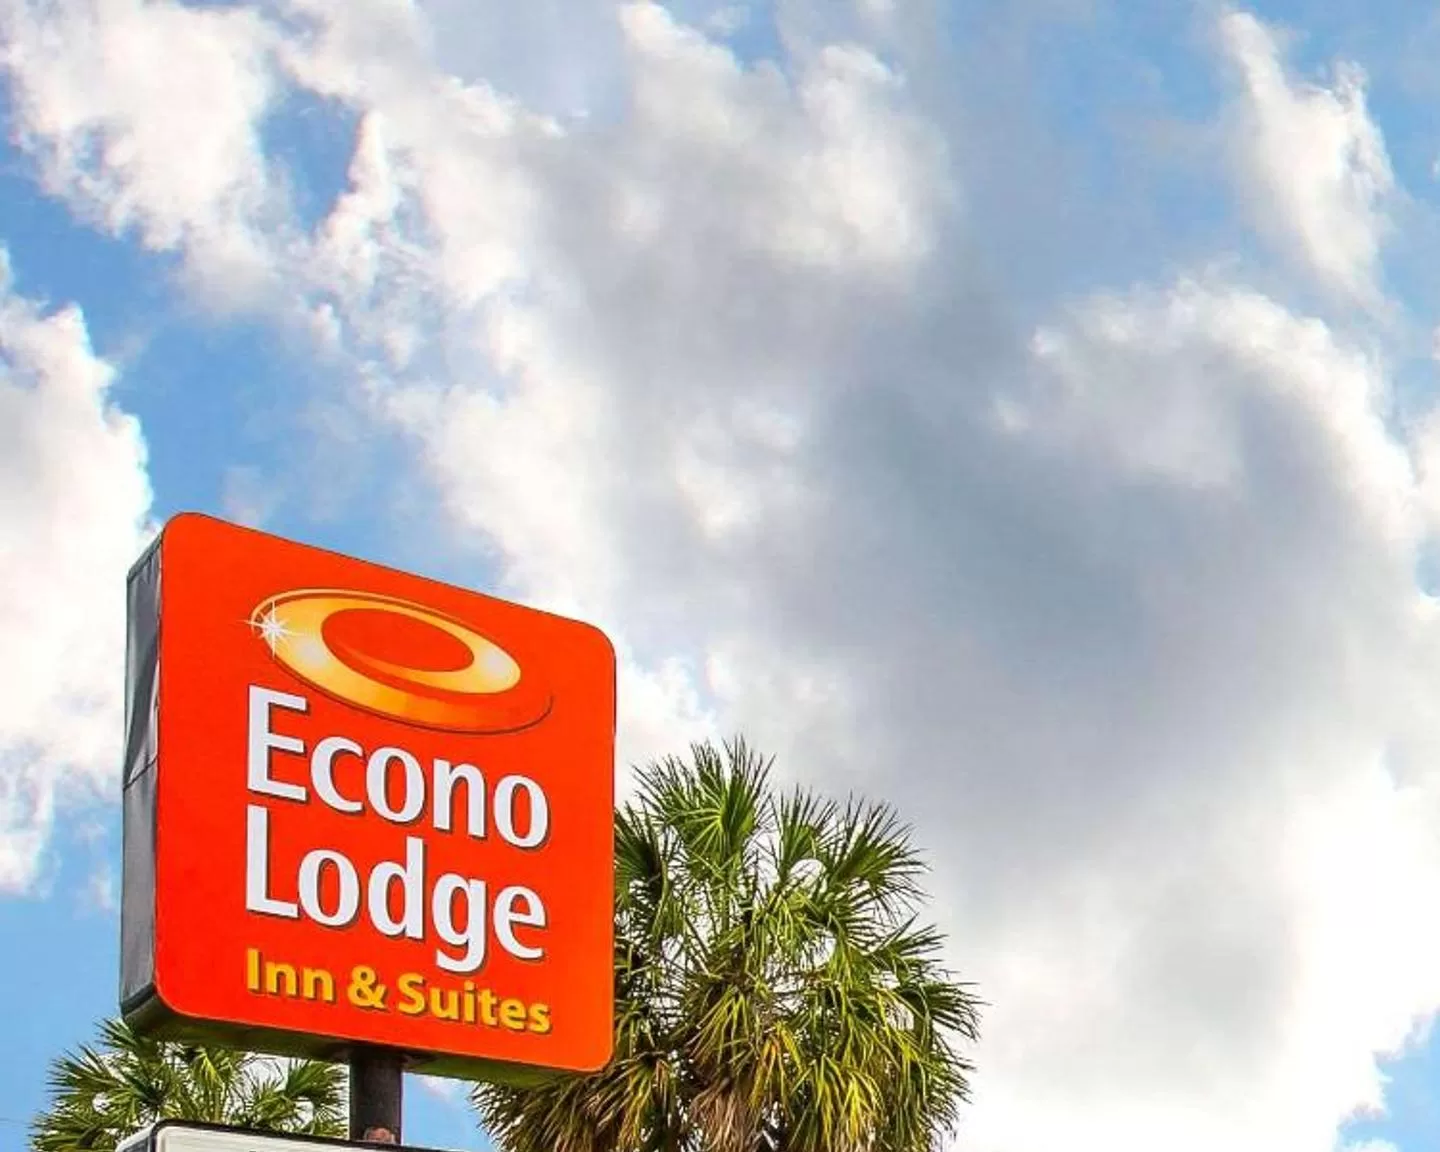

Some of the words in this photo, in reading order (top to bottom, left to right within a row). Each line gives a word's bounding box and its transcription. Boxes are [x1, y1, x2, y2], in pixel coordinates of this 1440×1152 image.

[246, 684, 550, 849] Econo
[245, 804, 547, 973] Lodge
[246, 948, 335, 1002] Inn
[348, 965, 388, 1011] &
[398, 971, 552, 1034] Suites
